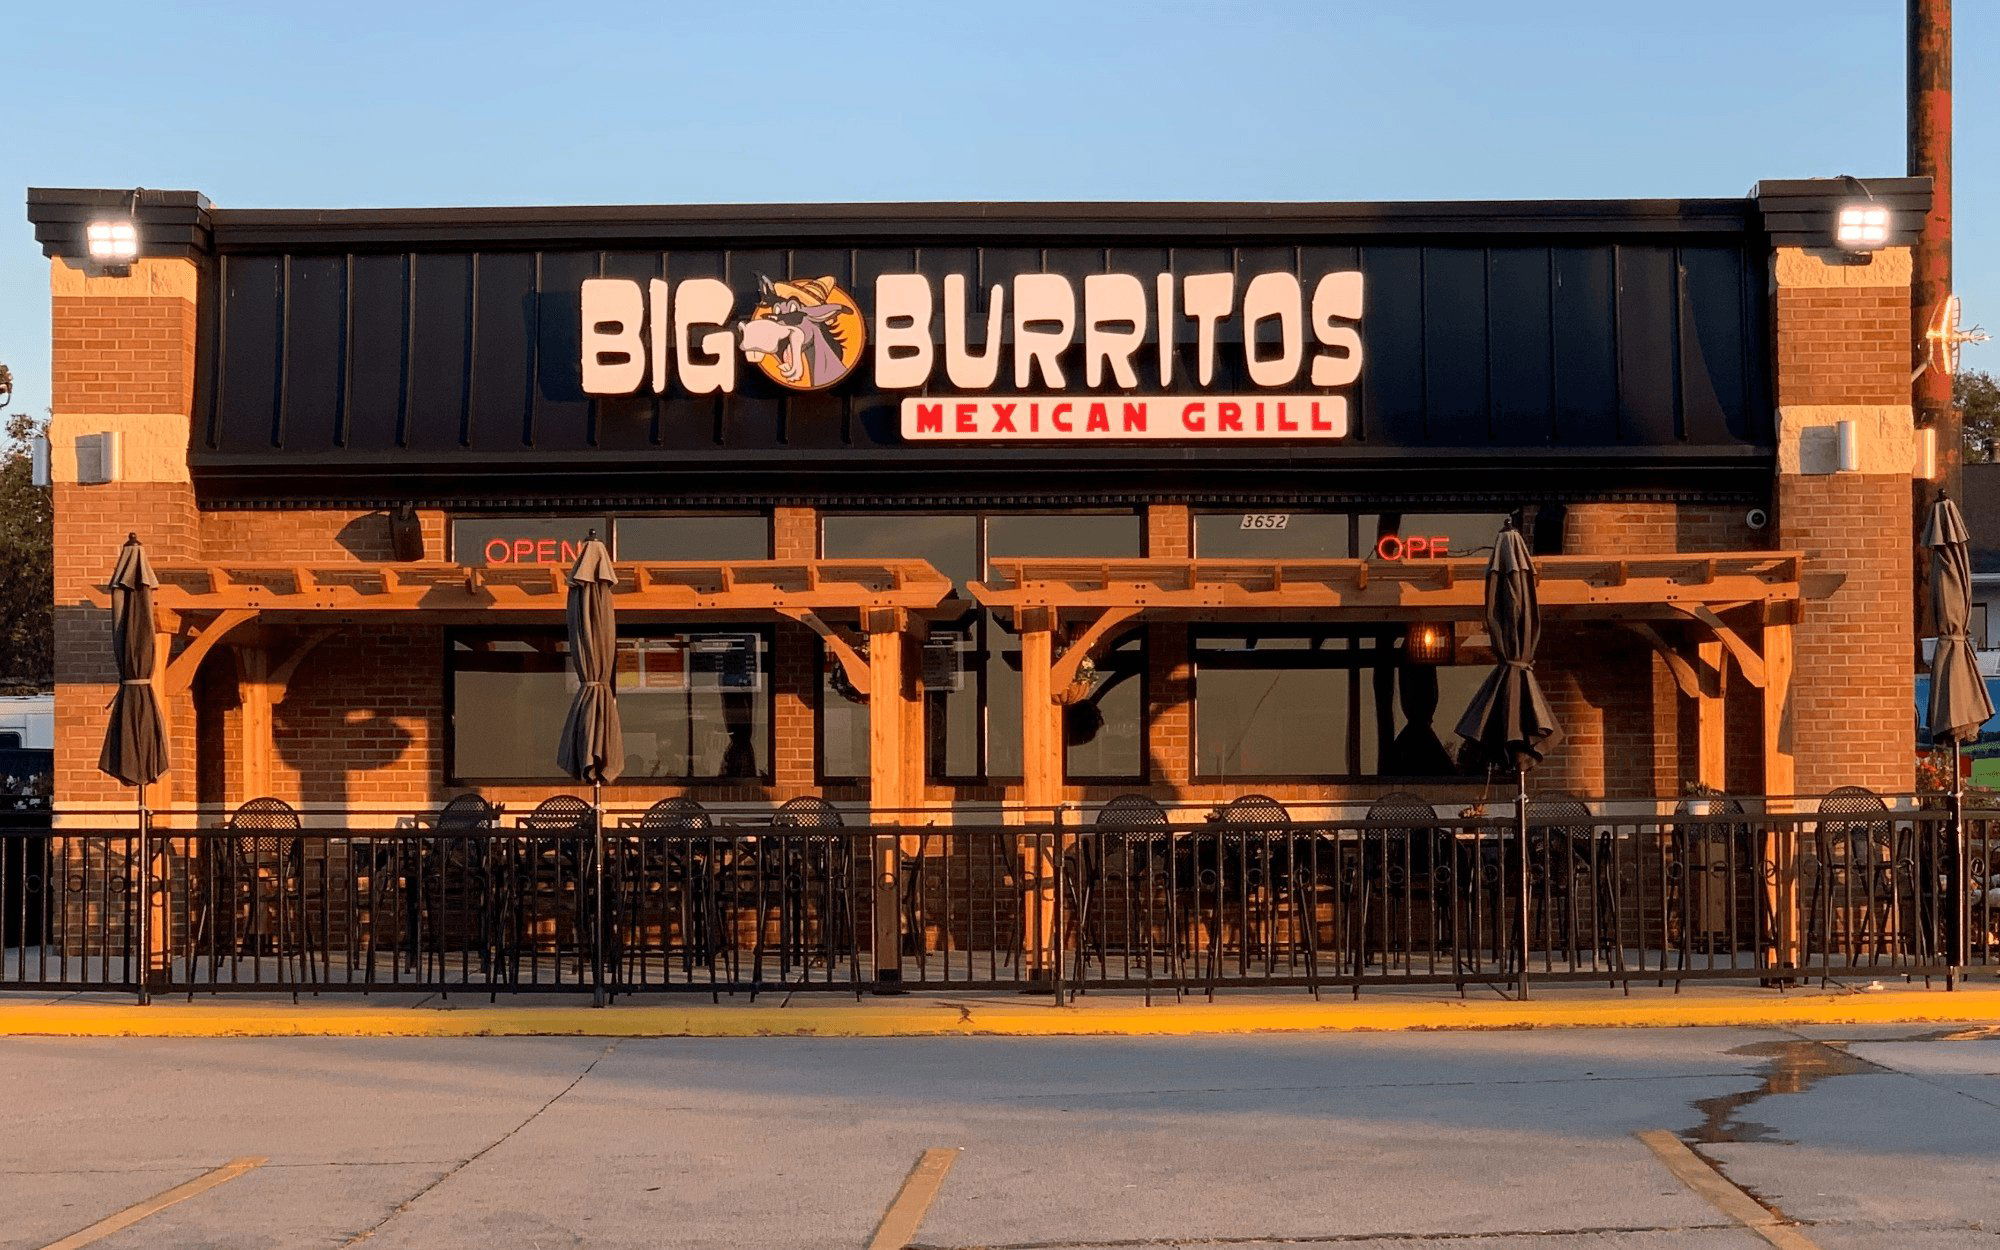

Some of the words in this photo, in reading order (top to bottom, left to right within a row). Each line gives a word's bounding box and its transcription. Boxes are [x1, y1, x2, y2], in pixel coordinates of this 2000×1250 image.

[580, 278, 734, 394] BIG
[875, 271, 1365, 389] BURRITOS
[916, 402, 1147, 433] MEXICAN
[1181, 402, 1332, 433] GRILL
[1243, 515, 1286, 528] 3652
[485, 538, 583, 563] OPEN
